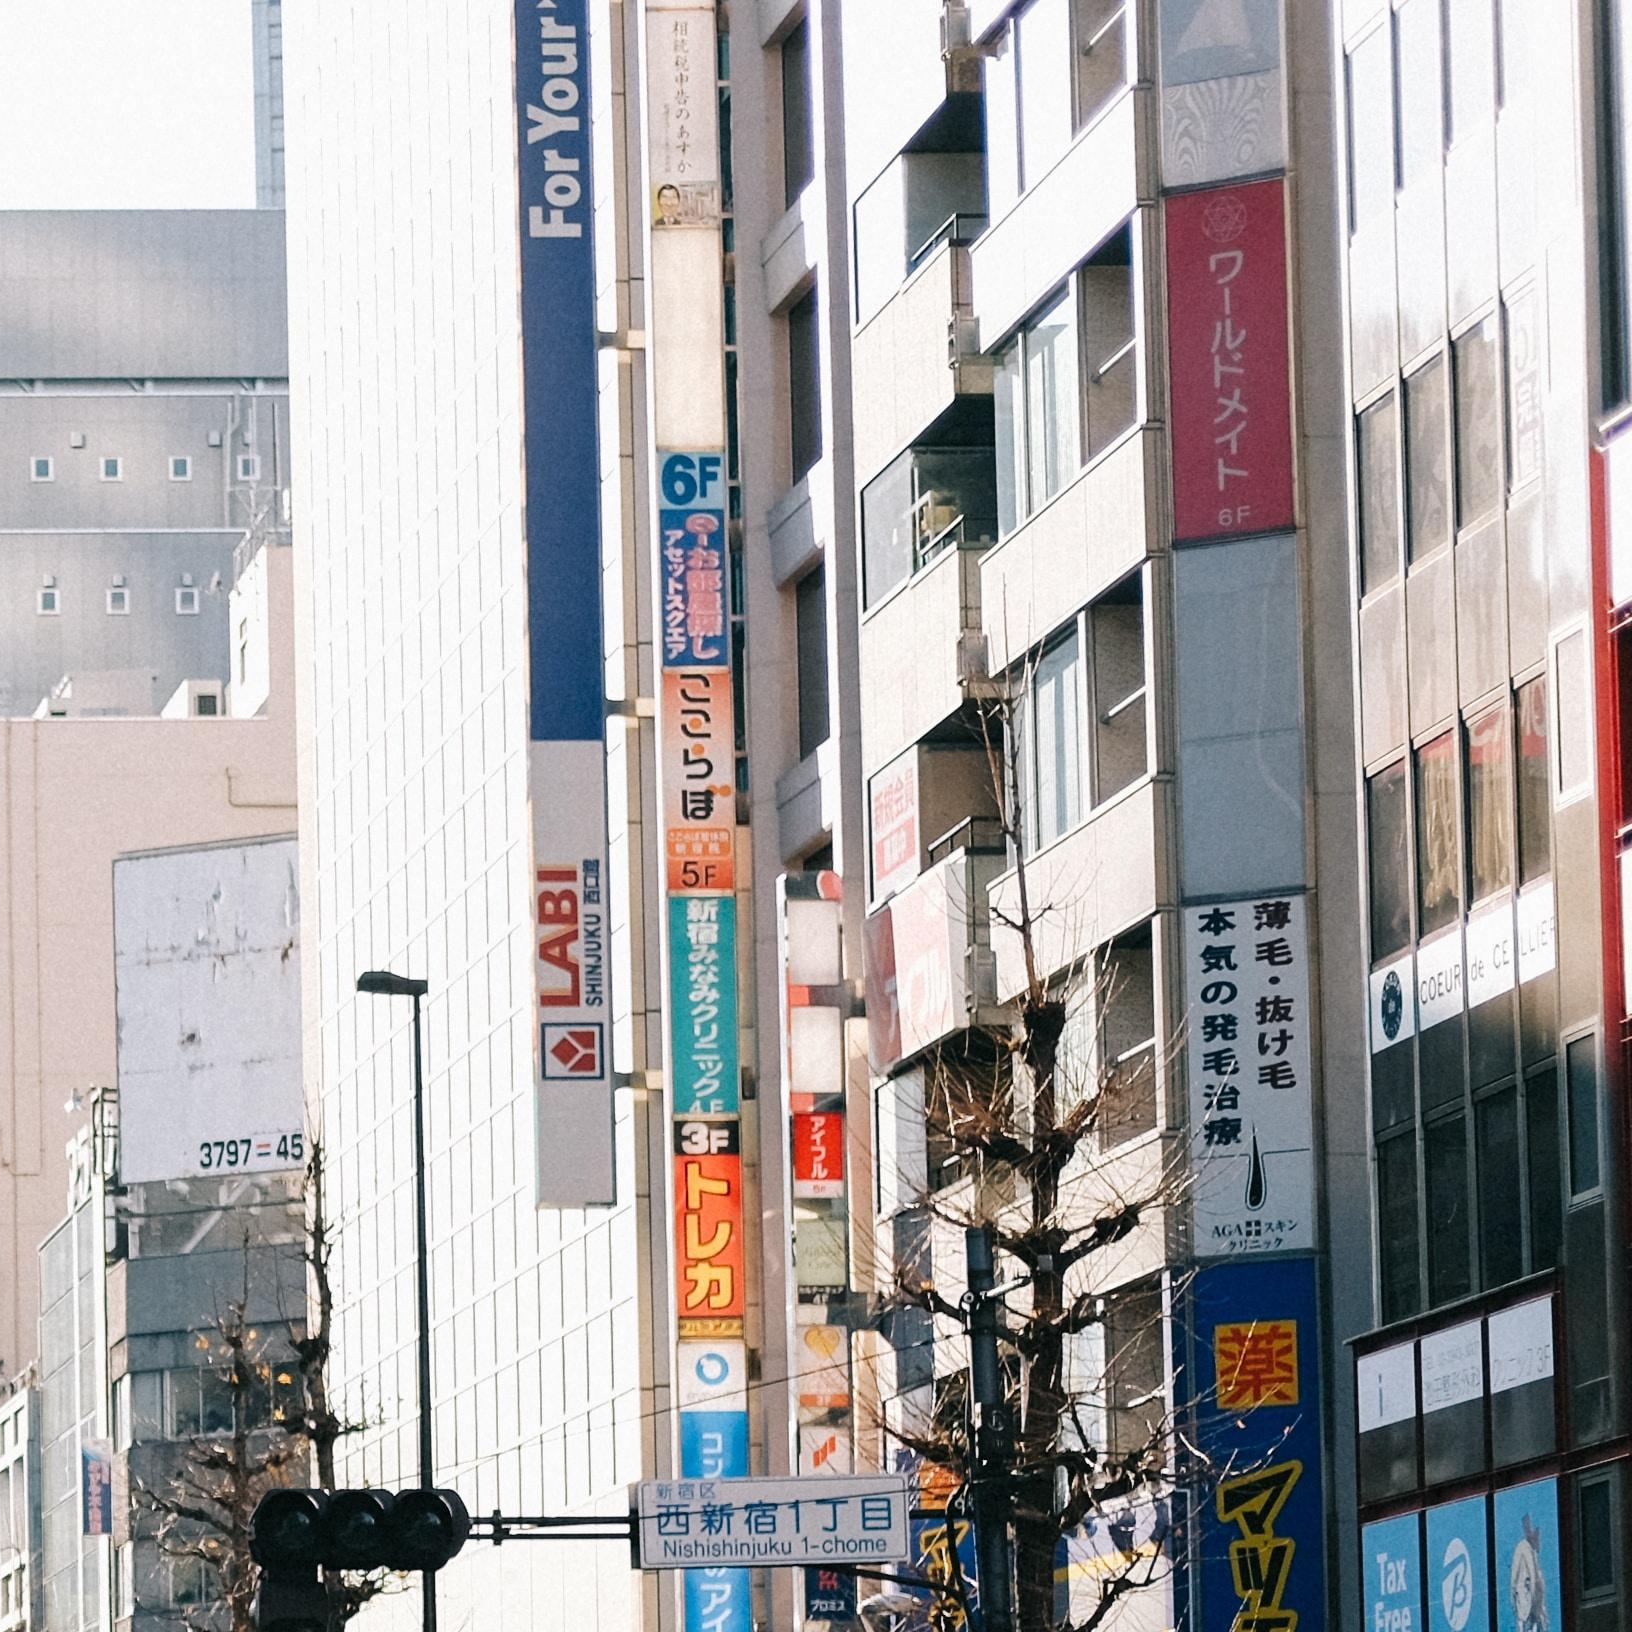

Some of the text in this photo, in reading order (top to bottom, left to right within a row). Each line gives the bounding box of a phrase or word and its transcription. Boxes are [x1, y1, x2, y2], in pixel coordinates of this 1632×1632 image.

[529, 149, 583, 240] For
[1209, 250, 1249, 491] ワールドメイト
[662, 454, 721, 506] 6F
[1217, 504, 1252, 527] 6F
[664, 529, 687, 660] アセットスクエア
[681, 861, 717, 888] 5F
[537, 864, 581, 1008] LABI
[583, 914, 604, 1008] SHINJUKU
[687, 898, 724, 1098] 新宿みなみクリニック
[1253, 901, 1297, 1091] 薄毛・抜け毛
[1419, 963, 1461, 1005] COEUR
[1471, 955, 1485, 982] de
[1197, 907, 1243, 1147] 本気の発毛治療
[681, 1121, 730, 1155] 3F
[810, 1116, 828, 1179] アイフル
[684, 1158, 735, 1311] トレカ
[1211, 1219, 1298, 1239] AGA スキン
[1229, 1237, 1284, 1252] クリニック
[1216, 1326, 1293, 1402] 薬
[655, 1481, 717, 1499] 新宿区
[655, 1498, 893, 1537] 西新宿1丁目
[663, 1535, 887, 1561] Nishishinjuku 1-chome
[1376, 1552, 1408, 1596] Tax
[810, 1599, 846, 1612] プロミス
